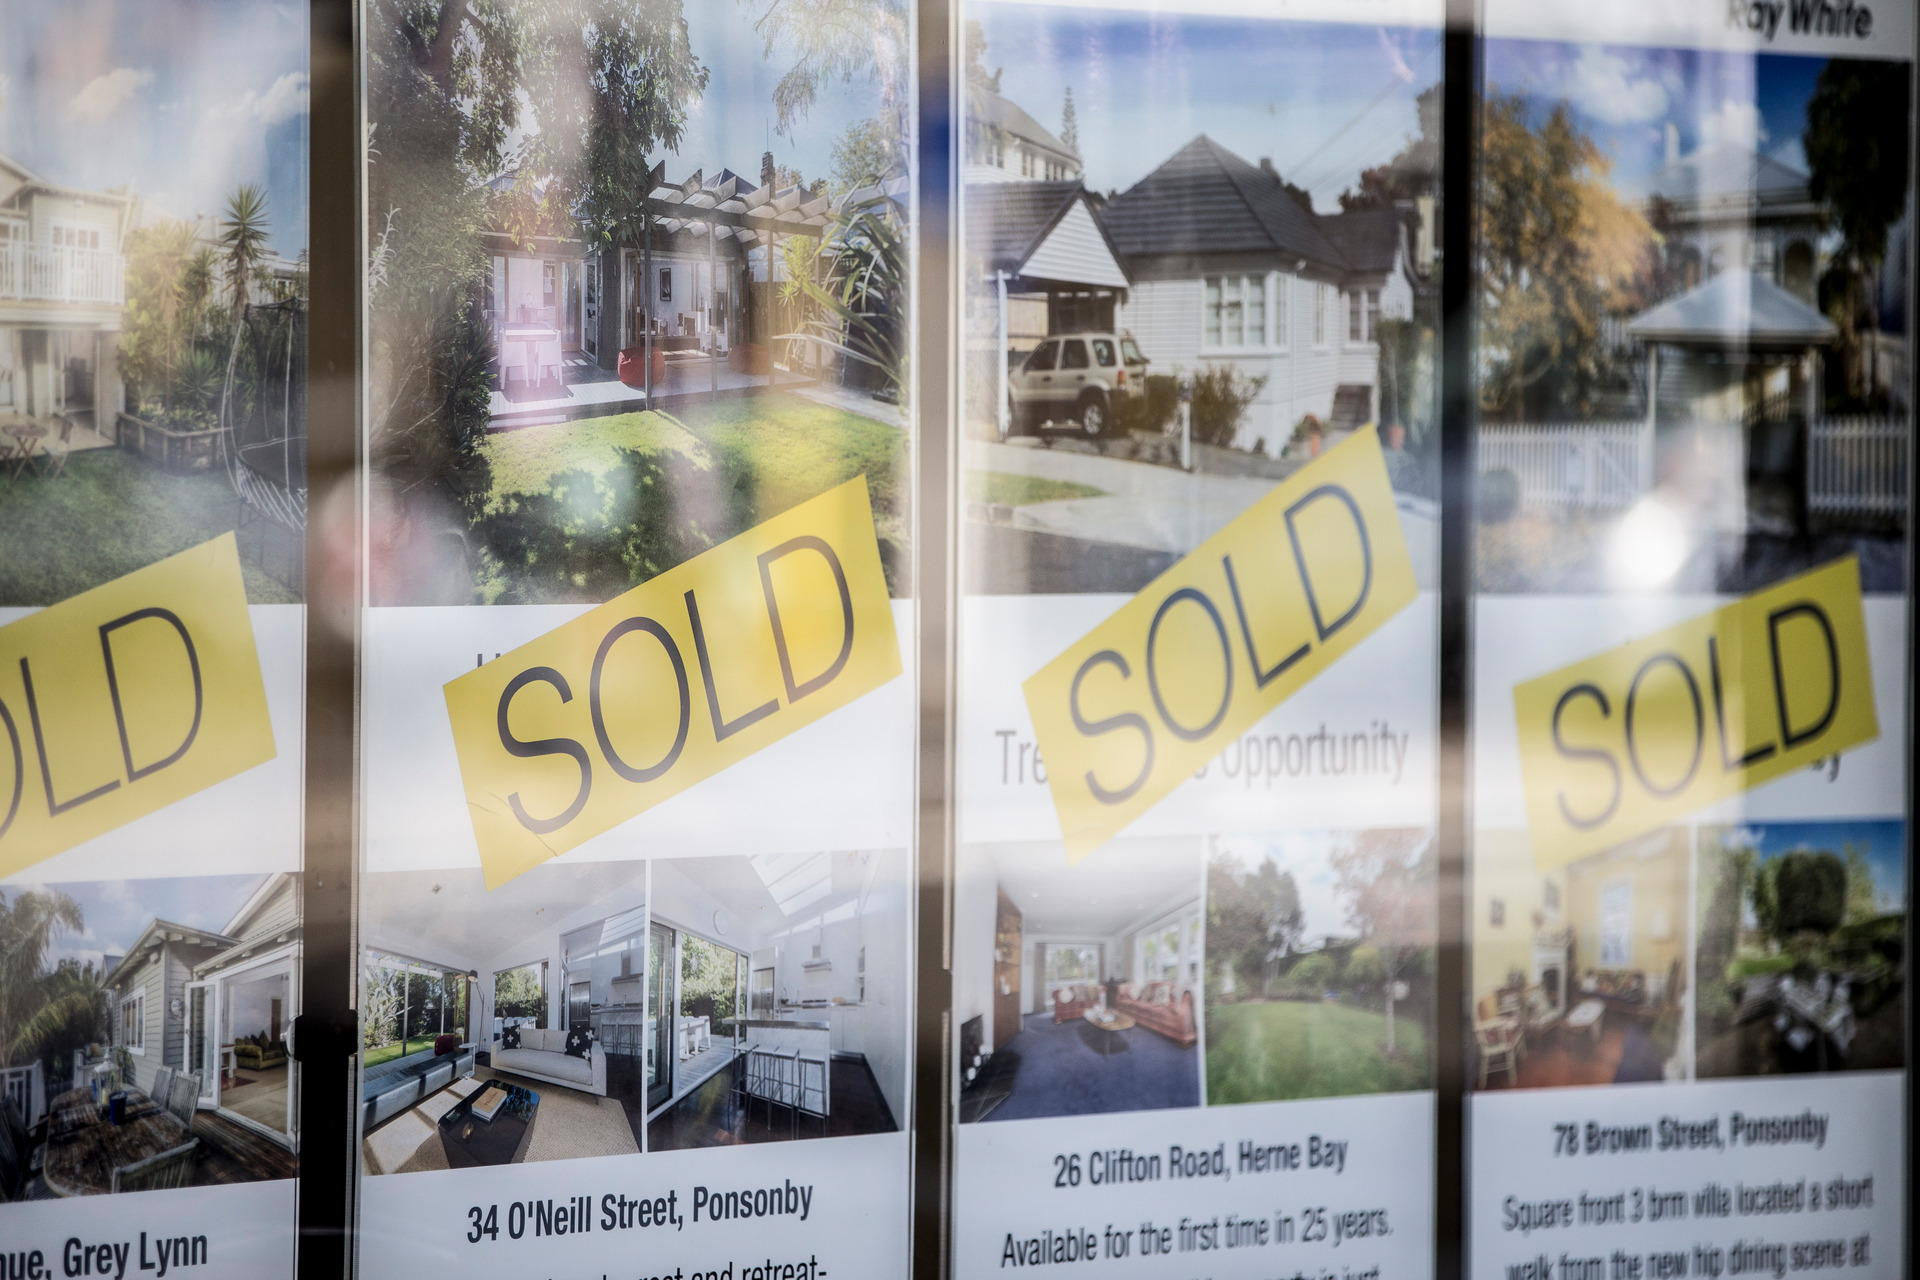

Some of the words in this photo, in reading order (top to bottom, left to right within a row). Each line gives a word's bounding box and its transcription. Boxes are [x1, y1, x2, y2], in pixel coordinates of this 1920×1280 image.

[1789, 0, 1873, 39] White
[1070, 482, 1374, 806] SOLD
[496, 534, 855, 835] SOLD
[1551, 598, 1843, 832] SOLD
[0, 606, 203, 840] LD
[1053, 1153, 1082, 1188] 26
[1088, 1147, 1162, 1185] Clifton
[1169, 1142, 1231, 1182] Road,
[1237, 1138, 1301, 1175] Herne
[1308, 1134, 1348, 1174] Bay
[1584, 1118, 1653, 1156] Brown
[1657, 1114, 1726, 1153] Street,
[1729, 1108, 1831, 1149] Ponsonby
[467, 1205, 500, 1243] 34
[508, 1196, 592, 1240] O'Neill
[600, 1189, 684, 1231] Street,
[693, 1178, 814, 1222] Ponsonby
[1501, 1193, 1574, 1236] Square
[1577, 1188, 1625, 1224] front
[1735, 1177, 1805, 1217] located
[1824, 1173, 1874, 1210] short
[63, 1237, 130, 1280] Grey
[140, 1232, 207, 1278] Lynn
[742, 1254, 827, 1280] retreat-
[1001, 1222, 1098, 1268] Available
[1104, 1219, 1133, 1259] for
[1139, 1216, 1172, 1255] the
[1178, 1212, 1219, 1252] first
[1225, 1211, 1270, 1247] time
[1275, 1210, 1295, 1243] in
[1301, 1207, 1328, 1242] 25
[1332, 1207, 1394, 1247] years.
[1726, 1237, 1787, 1279] dining
[1789, 1238, 1847, 1271] scene
